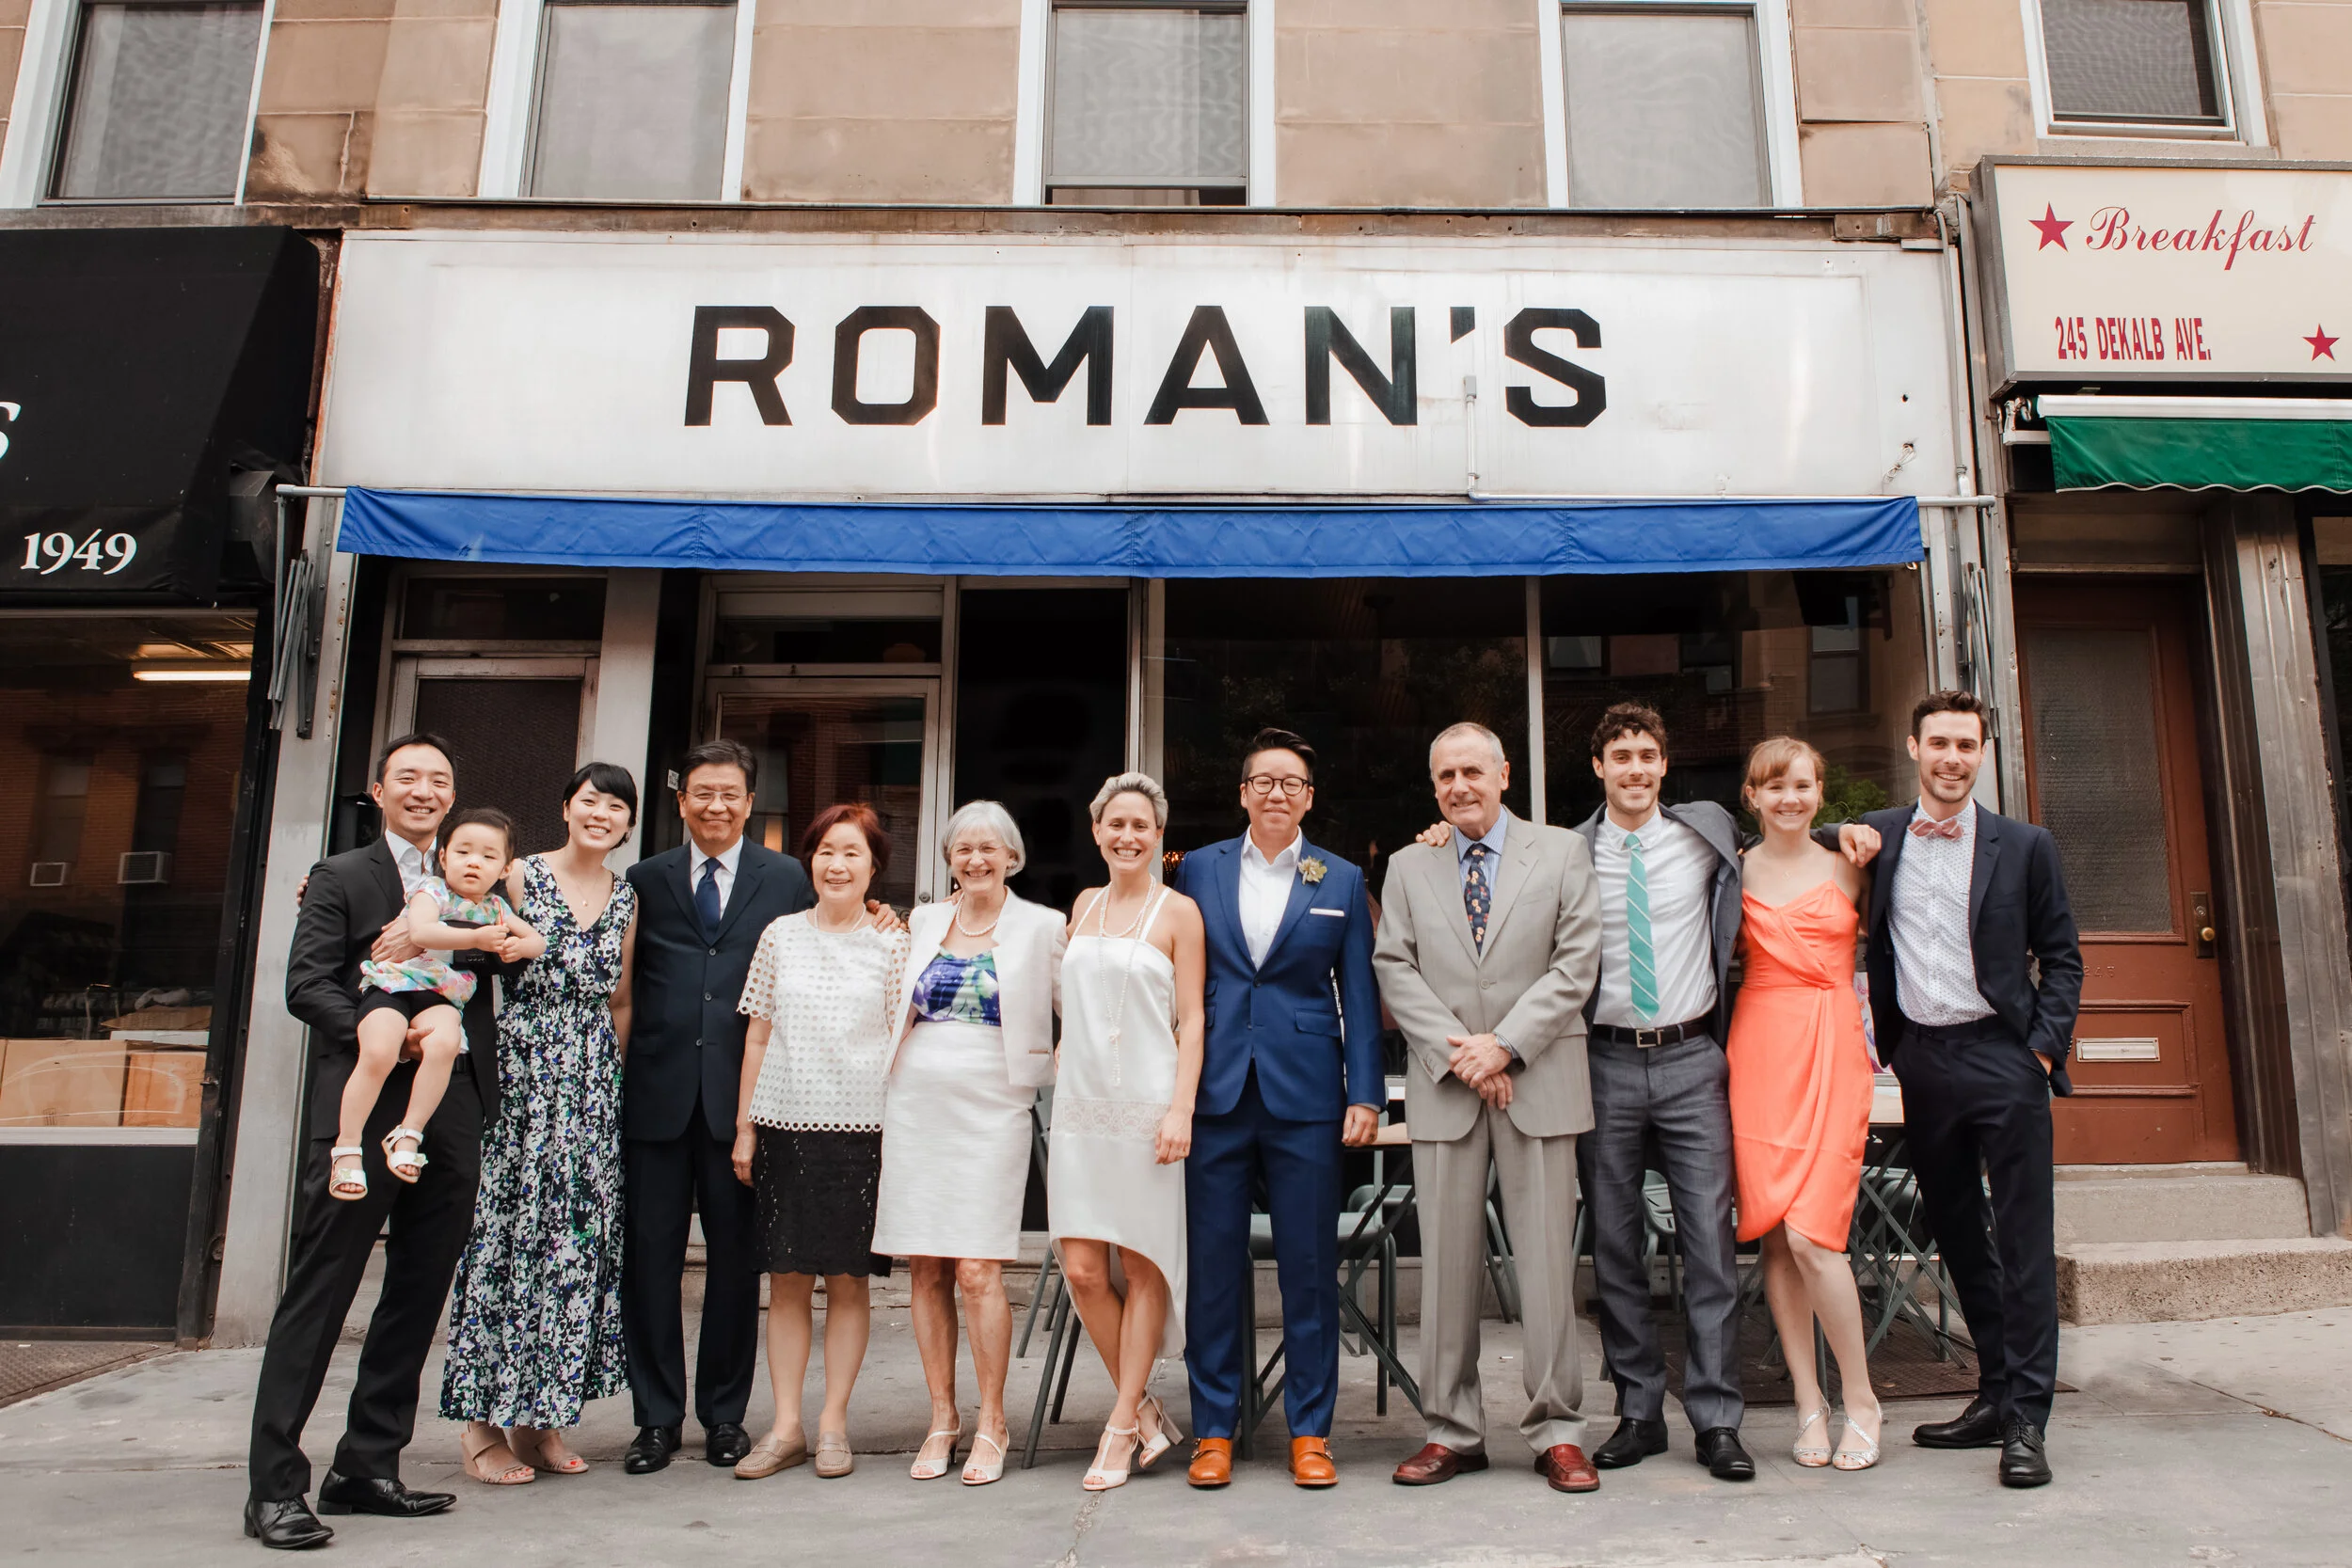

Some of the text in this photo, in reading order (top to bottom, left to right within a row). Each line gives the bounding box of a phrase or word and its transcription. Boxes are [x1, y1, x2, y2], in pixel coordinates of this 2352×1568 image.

[2085, 205, 2316, 271] Breakfast
[684, 305, 1607, 428] ROMAN'S
[2055, 316, 2212, 361] 245 DEKALB AVE.
[20, 528, 137, 576] 1949
